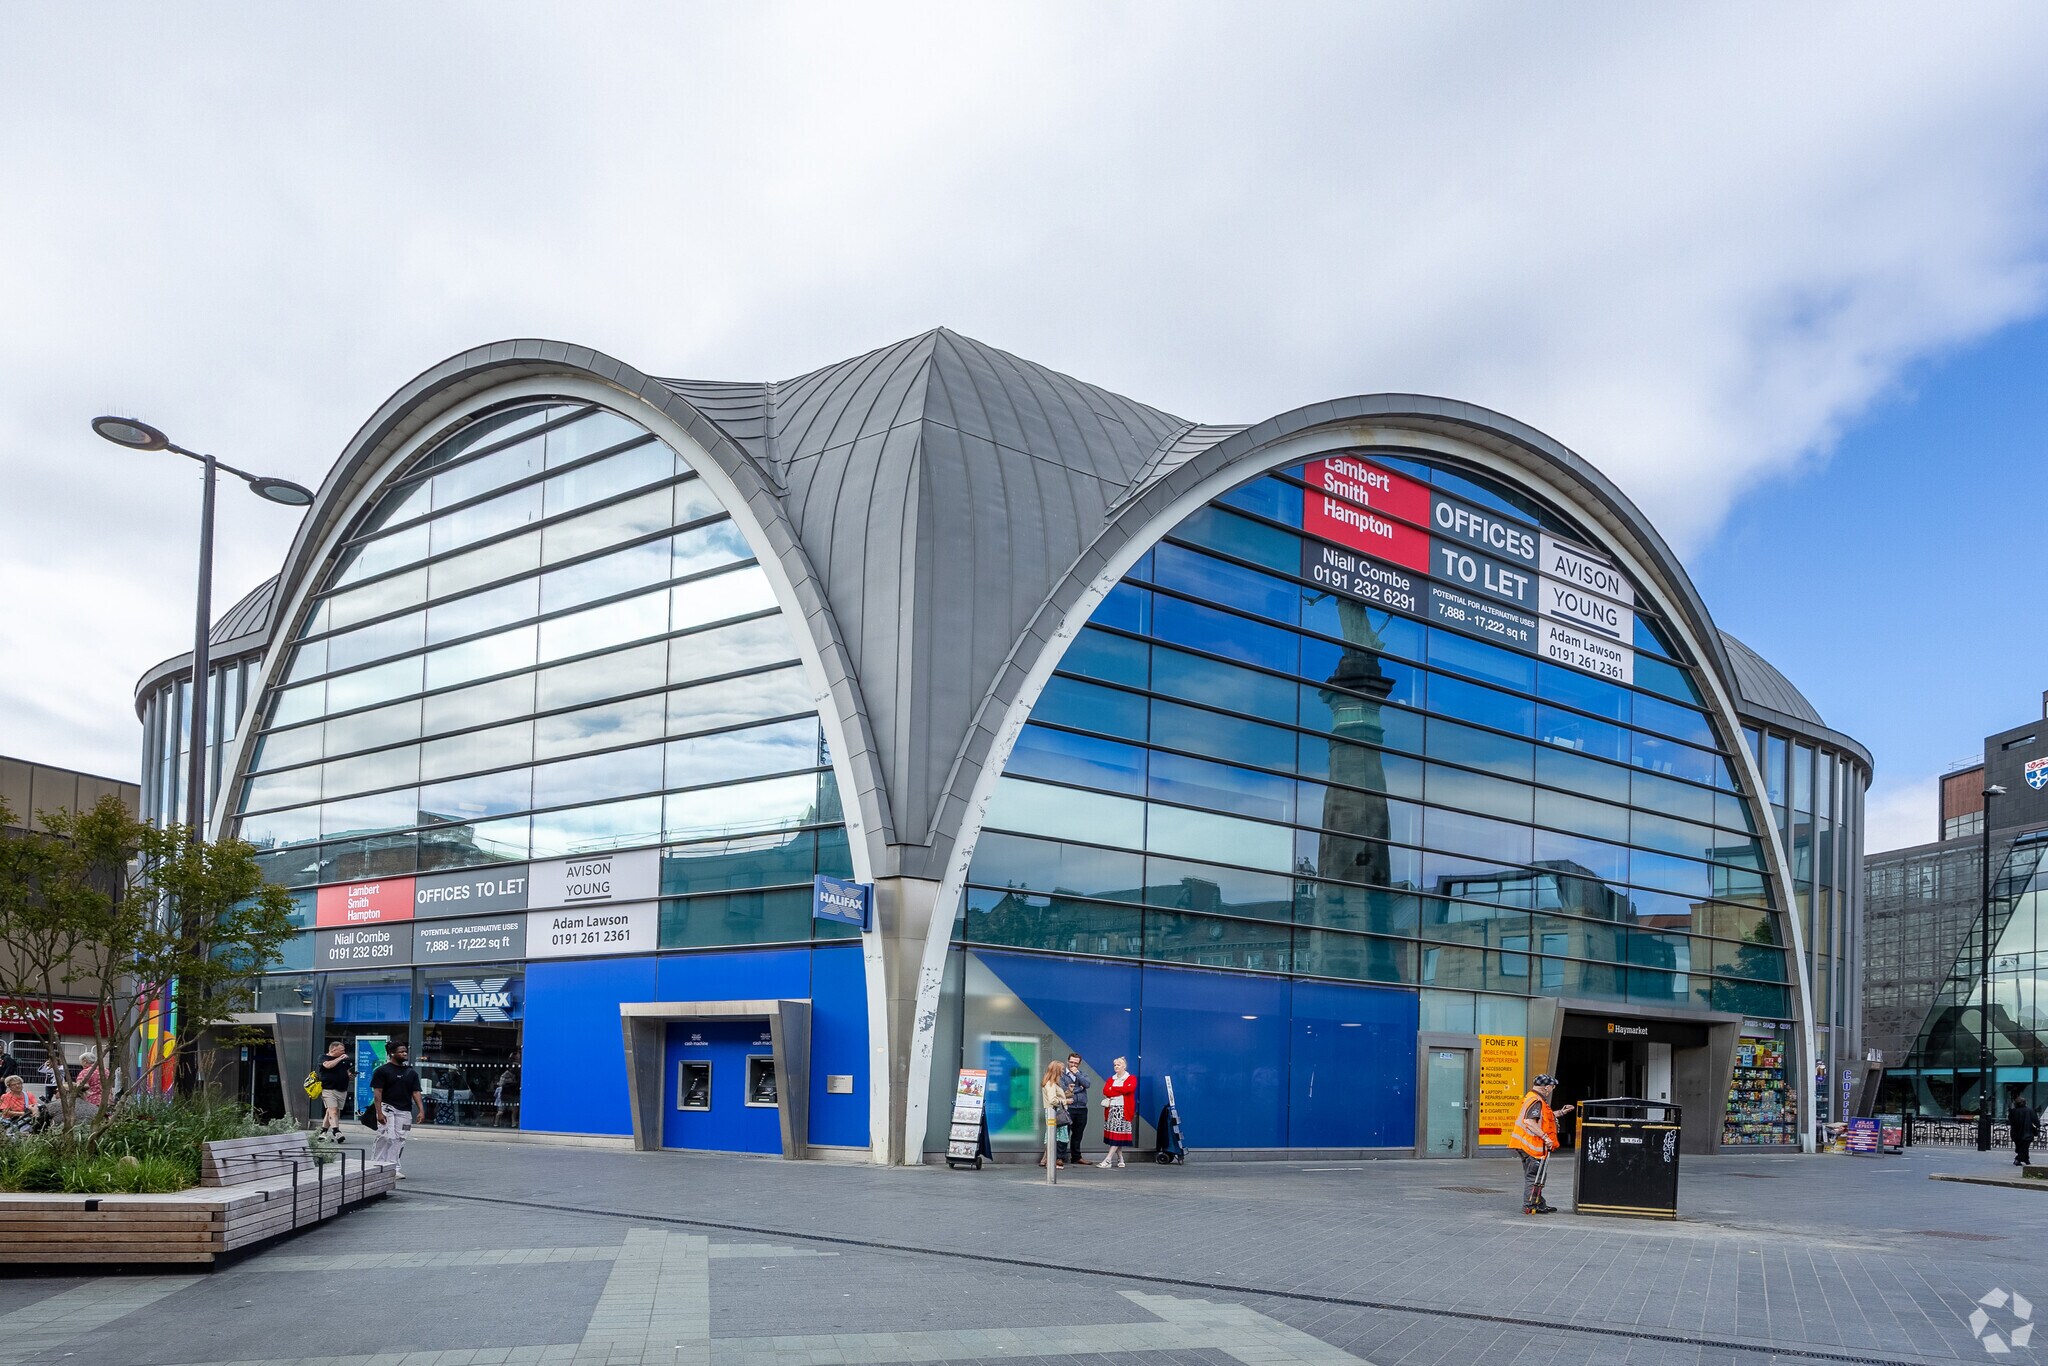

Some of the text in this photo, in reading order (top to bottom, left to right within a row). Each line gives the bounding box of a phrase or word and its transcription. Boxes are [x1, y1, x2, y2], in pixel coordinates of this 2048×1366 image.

[1325, 458, 1390, 492] Lambert
[1324, 472, 1369, 505] Smith
[1324, 496, 1393, 539] Hampton
[1435, 502, 1535, 560] OFFICES
[1323, 547, 1410, 591] Niall Combe
[1441, 547, 1528, 600] TO LET
[1555, 555, 1619, 595] AVISON
[1314, 564, 1415, 611] 0191 232 6291
[1432, 588, 1535, 628] POTENTIAL FOR ALTERNATIVE USES
[1553, 587, 1618, 627] YOUNG
[1438, 603, 1466, 622] 7,888
[1474, 615, 1505, 634] 17,222
[1506, 627, 1518, 641] sq
[1520, 629, 1528, 641] ft
[1550, 627, 1622, 663] Adam Lawson
[1549, 644, 1623, 680] 0191 261 2361
[566, 862, 611, 878] AVISON
[348, 884, 380, 897] Lambert
[417, 878, 525, 904] OFFICES TO LET
[566, 881, 610, 896] YOUNG
[347, 897, 369, 909] Smith
[820, 892, 863, 911] HALIFAX
[347, 909, 381, 921] Hampton
[552, 915, 629, 930] Adam Lawson
[334, 930, 390, 946] Niall Combe
[420, 922, 519, 937] POTENTIAL FOR ALTERNATIVE USES
[551, 929, 630, 946] 0191 261 2361
[329, 944, 394, 961] 0191 232 6291
[425, 940, 449, 954] 7,888
[457, 937, 487, 952] 17,222
[488, 937, 501, 951] sq
[501, 936, 510, 947] ft
[448, 992, 511, 1009] HALIFAX
[0, 1004, 64, 1022] GANS
[1614, 1024, 1648, 1036] Haymarket
[1485, 1038, 1519, 1047] FONE FIX
[1842, 1069, 1852, 1122] COFFEE
